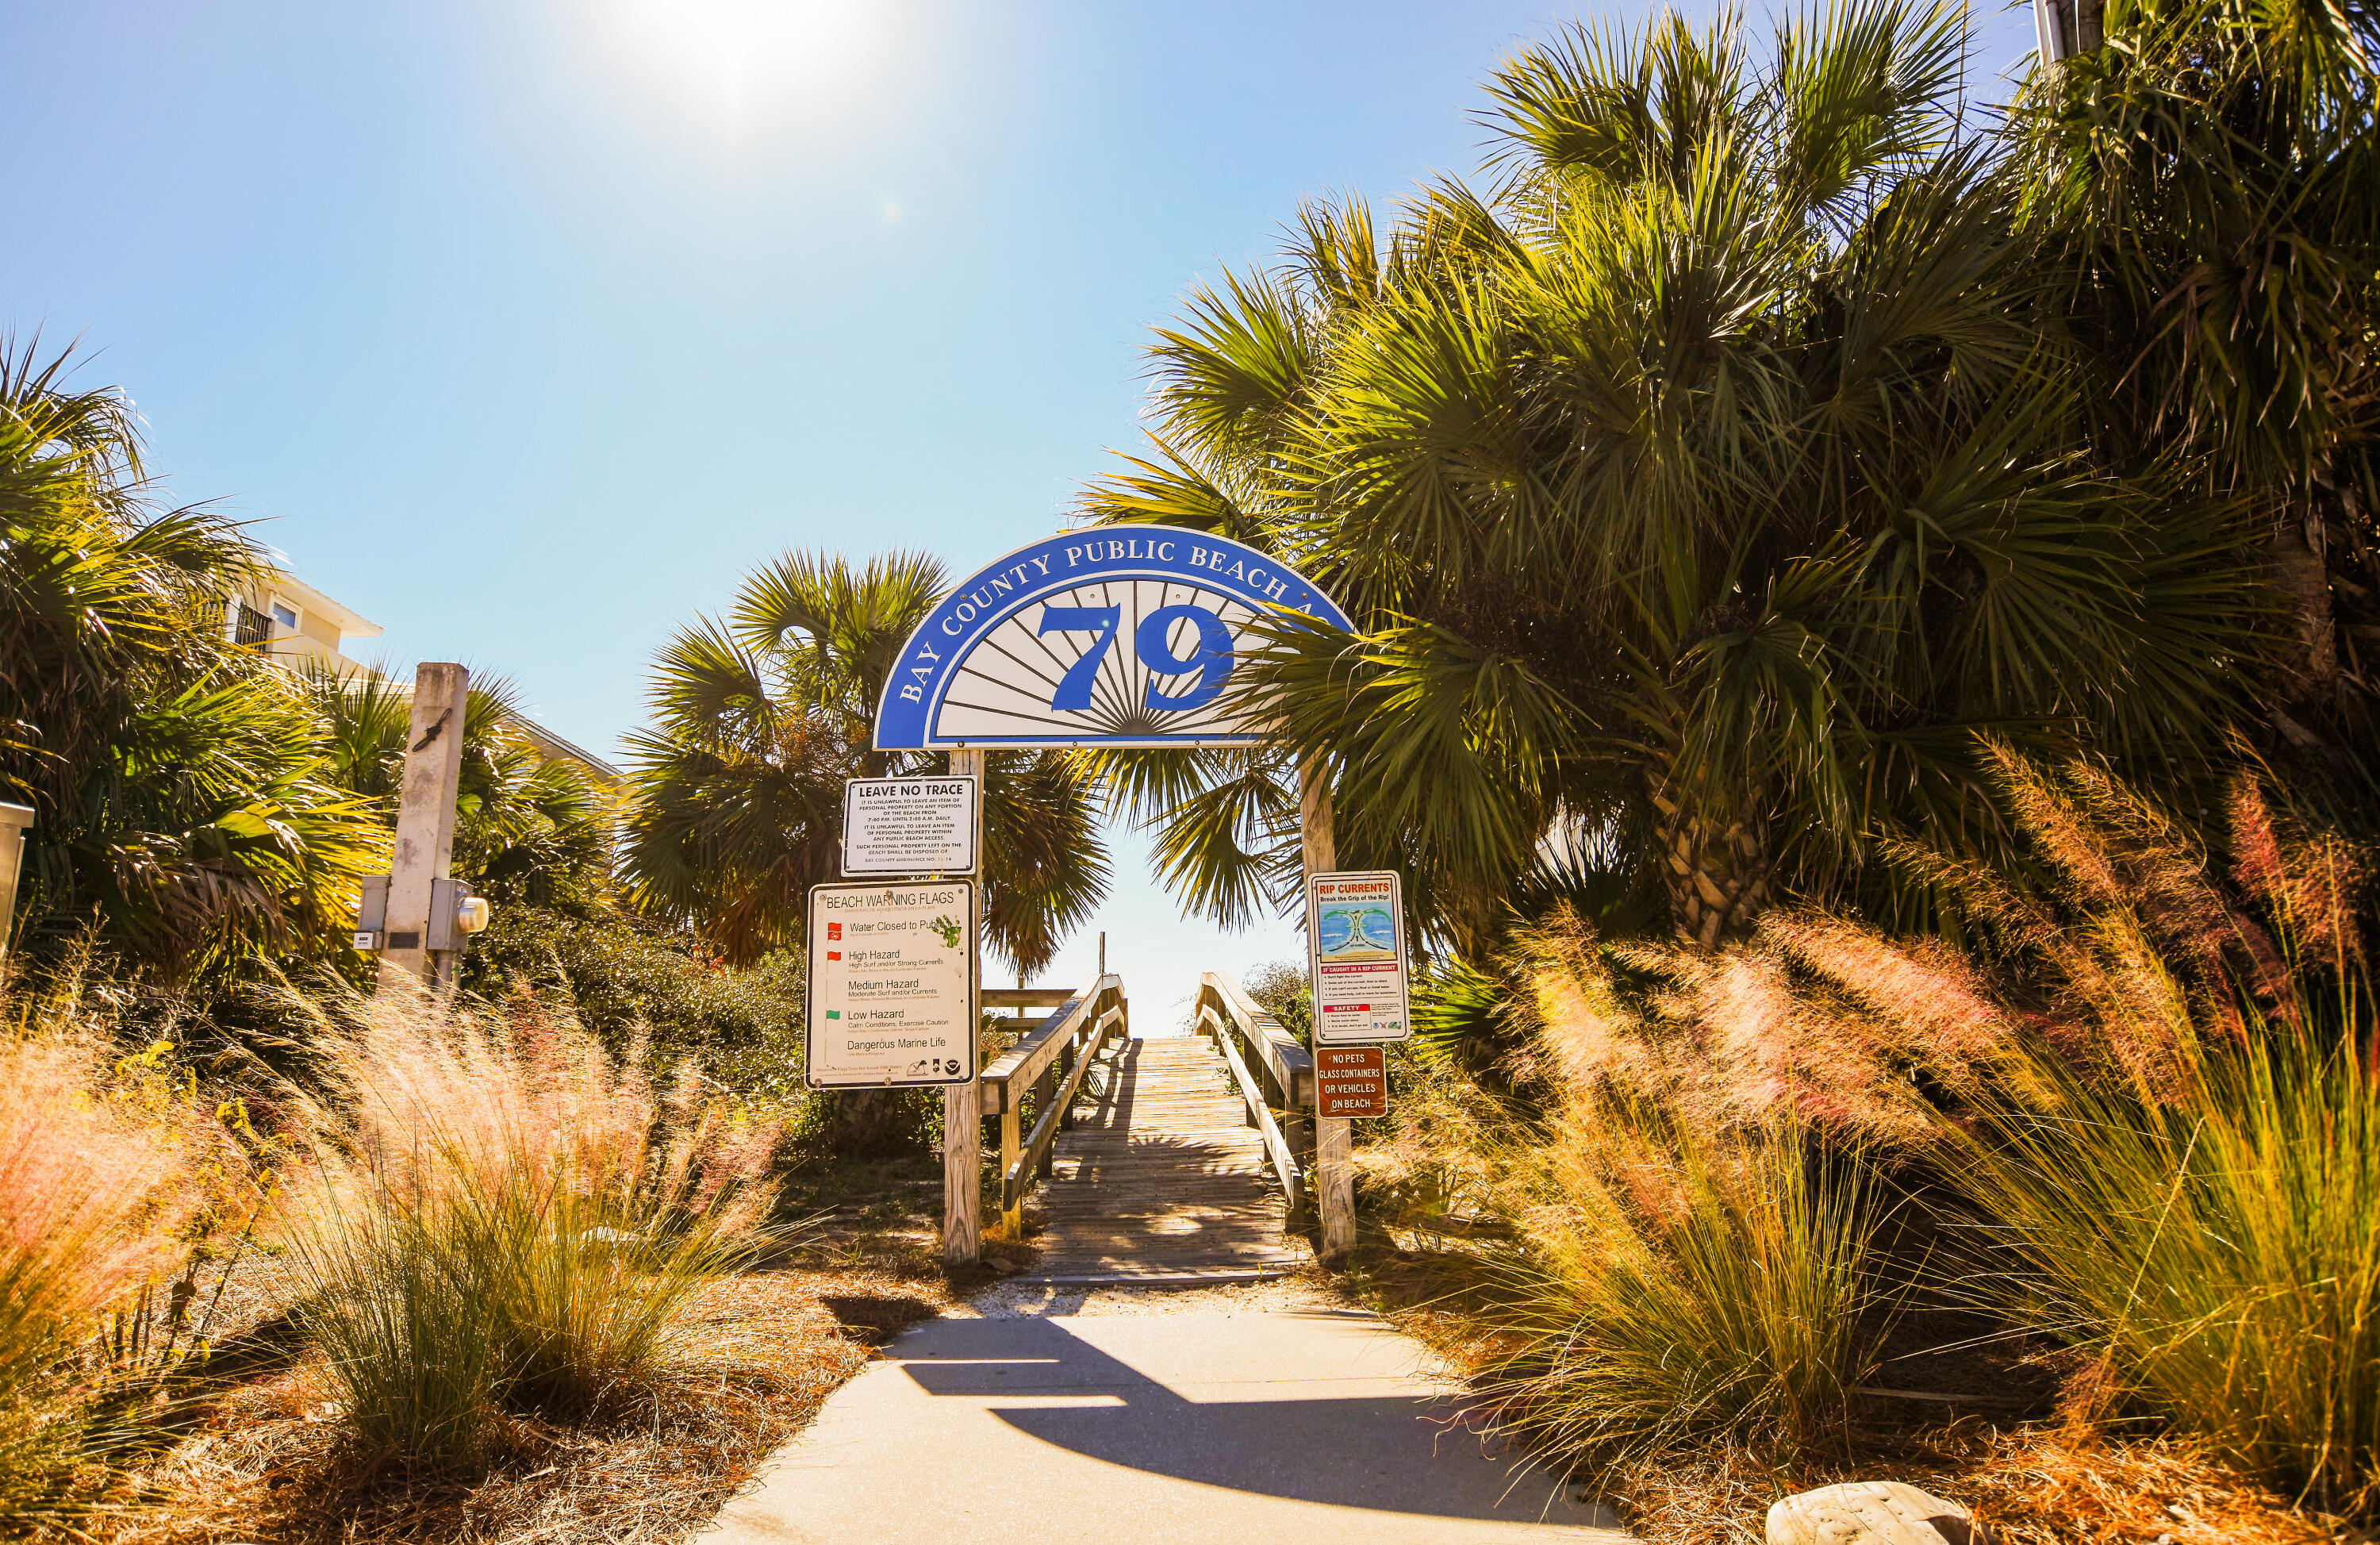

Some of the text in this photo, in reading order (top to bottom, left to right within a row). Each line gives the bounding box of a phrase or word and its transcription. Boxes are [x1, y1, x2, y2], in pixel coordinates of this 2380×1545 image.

[899, 540, 1289, 705] BAY COUNTY PUBLIC BEACH
[1037, 602, 1234, 712] 79
[859, 785, 963, 797] LEAVE NO TRACE
[1319, 882, 1389, 894] RIP CURRENTS
[827, 892, 954, 909] BEACH WARNING FLAGS
[850, 923, 874, 932] Water
[877, 921, 907, 931] Closed
[909, 921, 917, 930] to
[849, 949, 900, 962] High Hazard
[848, 978, 919, 990] Medium Hazard
[848, 1009, 904, 1020] Low Hazard
[847, 1037, 946, 1051] Dangerous Marine Life
[1333, 1054, 1365, 1063] NO PETS
[1319, 1068, 1380, 1079] GLASS CONTAINERS
[1325, 1083, 1376, 1093] OR VEHICLES
[1332, 1098, 1371, 1109] ON BEACH
